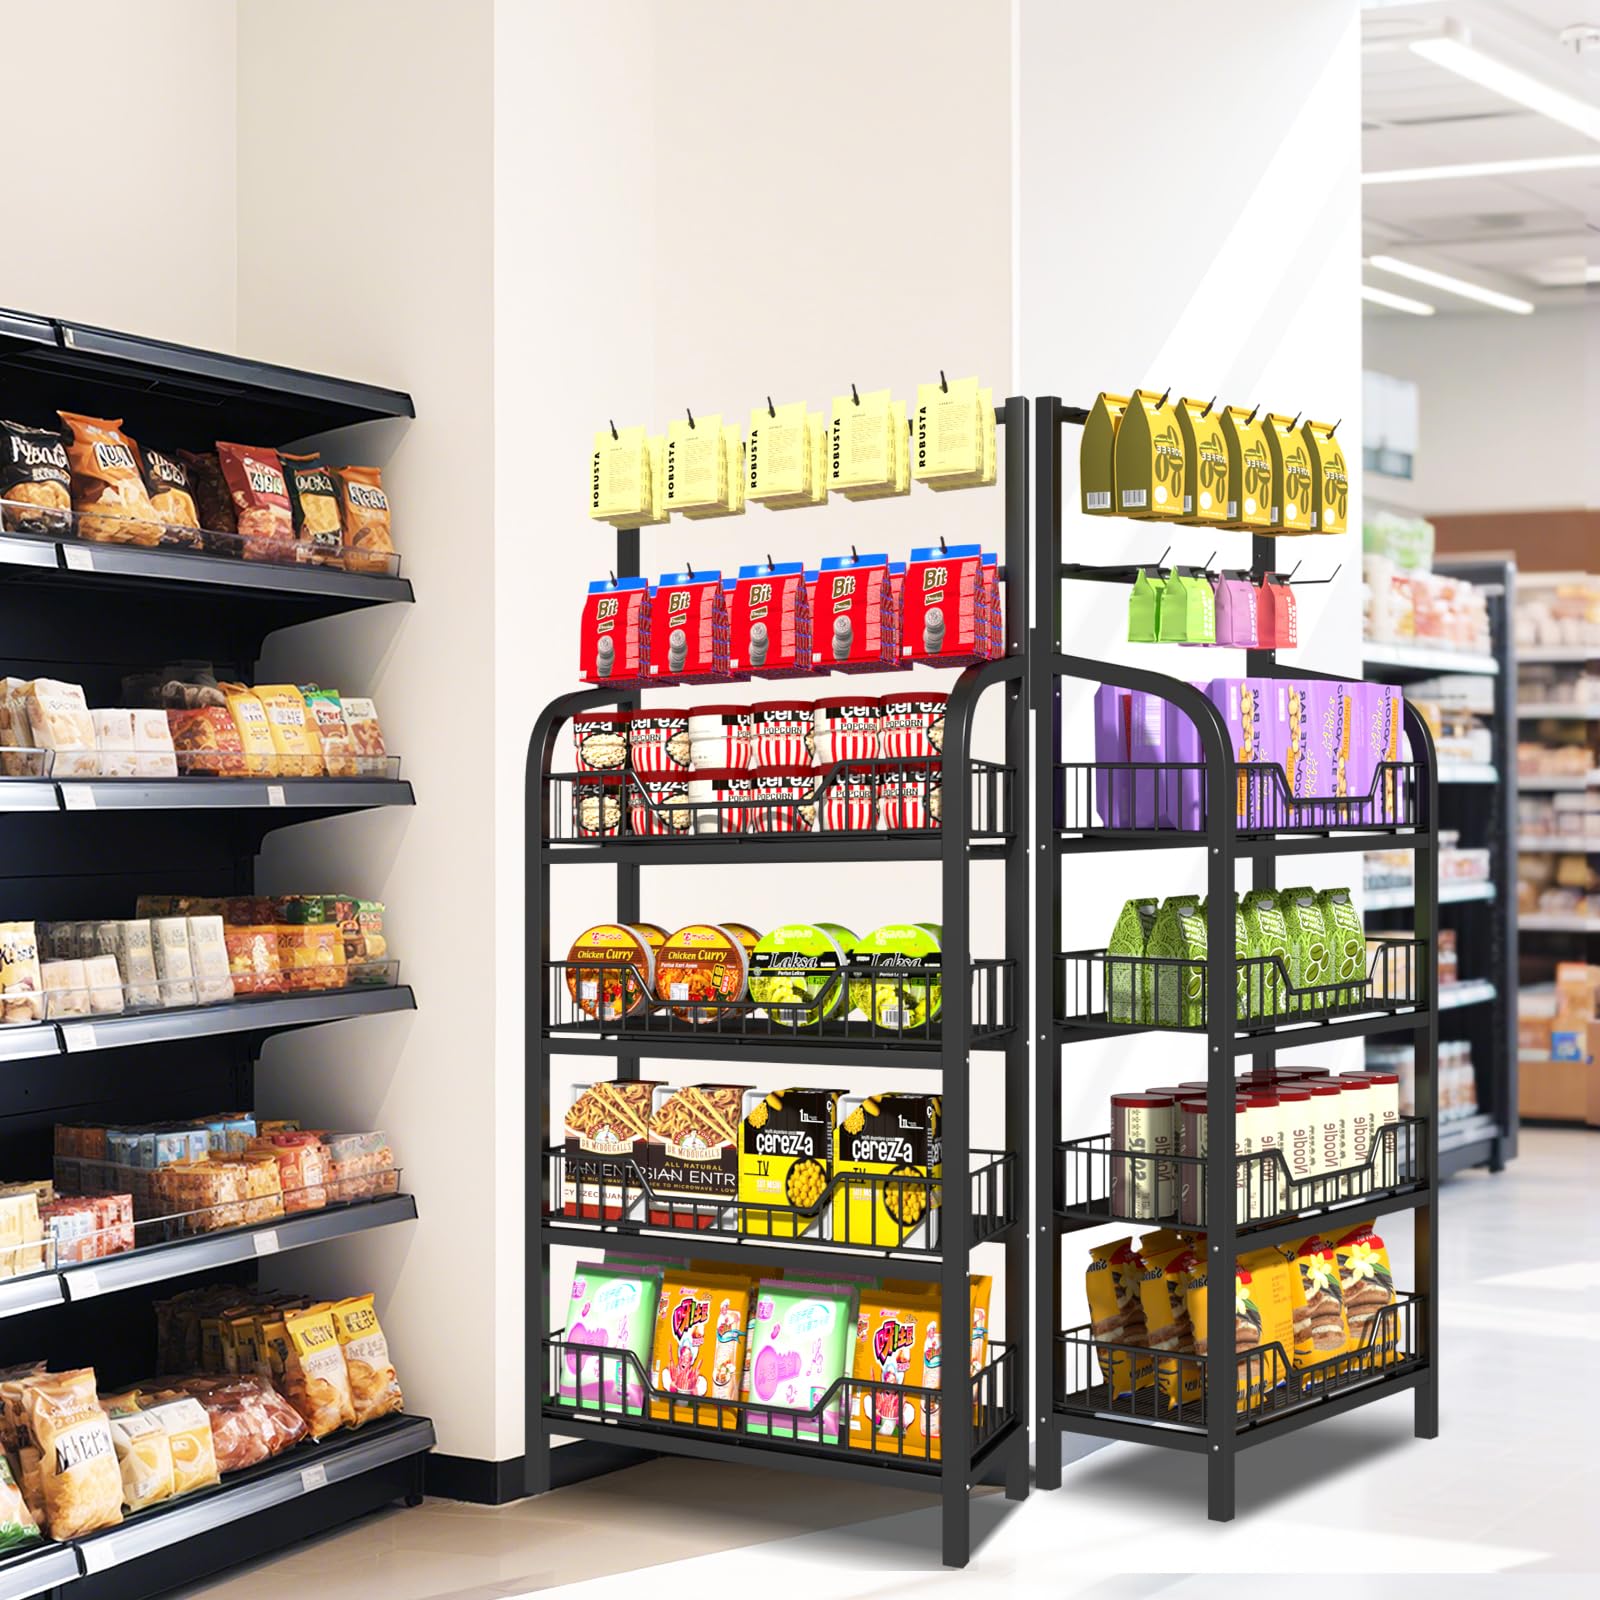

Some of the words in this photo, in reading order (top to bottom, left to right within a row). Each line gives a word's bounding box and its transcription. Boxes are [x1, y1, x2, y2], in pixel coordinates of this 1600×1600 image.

[923, 566, 948, 591] Bit
[832, 575, 856, 599] Bit
[668, 591, 691, 613] Bit
[749, 583, 772, 607] Bit
[597, 598, 618, 620] Bit
[886, 719, 923, 728] POPCORN
[764, 727, 802, 735] POPCORN
[757, 793, 794, 801] POPCORN
[578, 950, 604, 959] Chicken
[606, 948, 634, 961] Curry
[668, 951, 696, 960] Chicken
[698, 949, 727, 962] Curry
[768, 950, 818, 968] Laksa
[683, 1162, 723, 1171] NATURAL
[757, 1160, 769, 1176] TV
[674, 1183, 712, 1192] MICROWAVE
